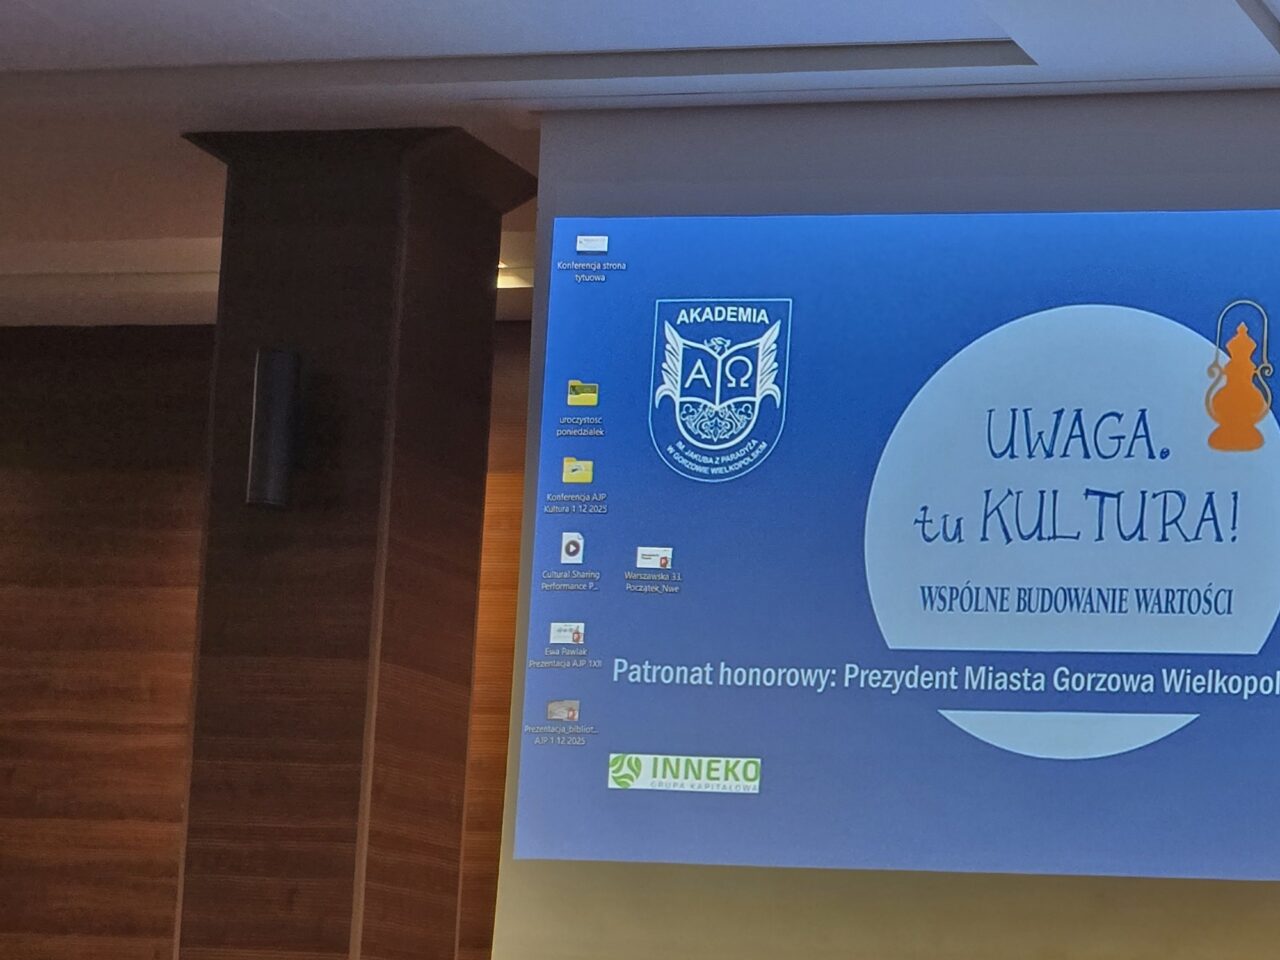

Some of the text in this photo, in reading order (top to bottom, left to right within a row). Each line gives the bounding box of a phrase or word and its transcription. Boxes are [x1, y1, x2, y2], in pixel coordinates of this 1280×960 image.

[557, 261, 626, 271] Konferencja strona
[677, 306, 769, 324] AKADEMIA
[986, 407, 1171, 460] UWAGA.
[666, 441, 768, 475] W GORZOWIE WIELKOPOLSKIM
[685, 449, 714, 465] JAKUBA
[714, 456, 720, 465] Z
[543, 505, 570, 513] Kultura
[914, 506, 964, 544] tu
[541, 582, 587, 590] Performance
[920, 580, 1234, 616] WSPÓLNE BUDOWANIE WARTOŚCI
[612, 658, 714, 685] Patronat
[719, 662, 837, 693] honorowy:
[844, 663, 958, 695] Prezydent
[964, 666, 1046, 692] Miasta
[1052, 667, 1155, 693] Gorzowa
[651, 756, 761, 783] INNEKO
